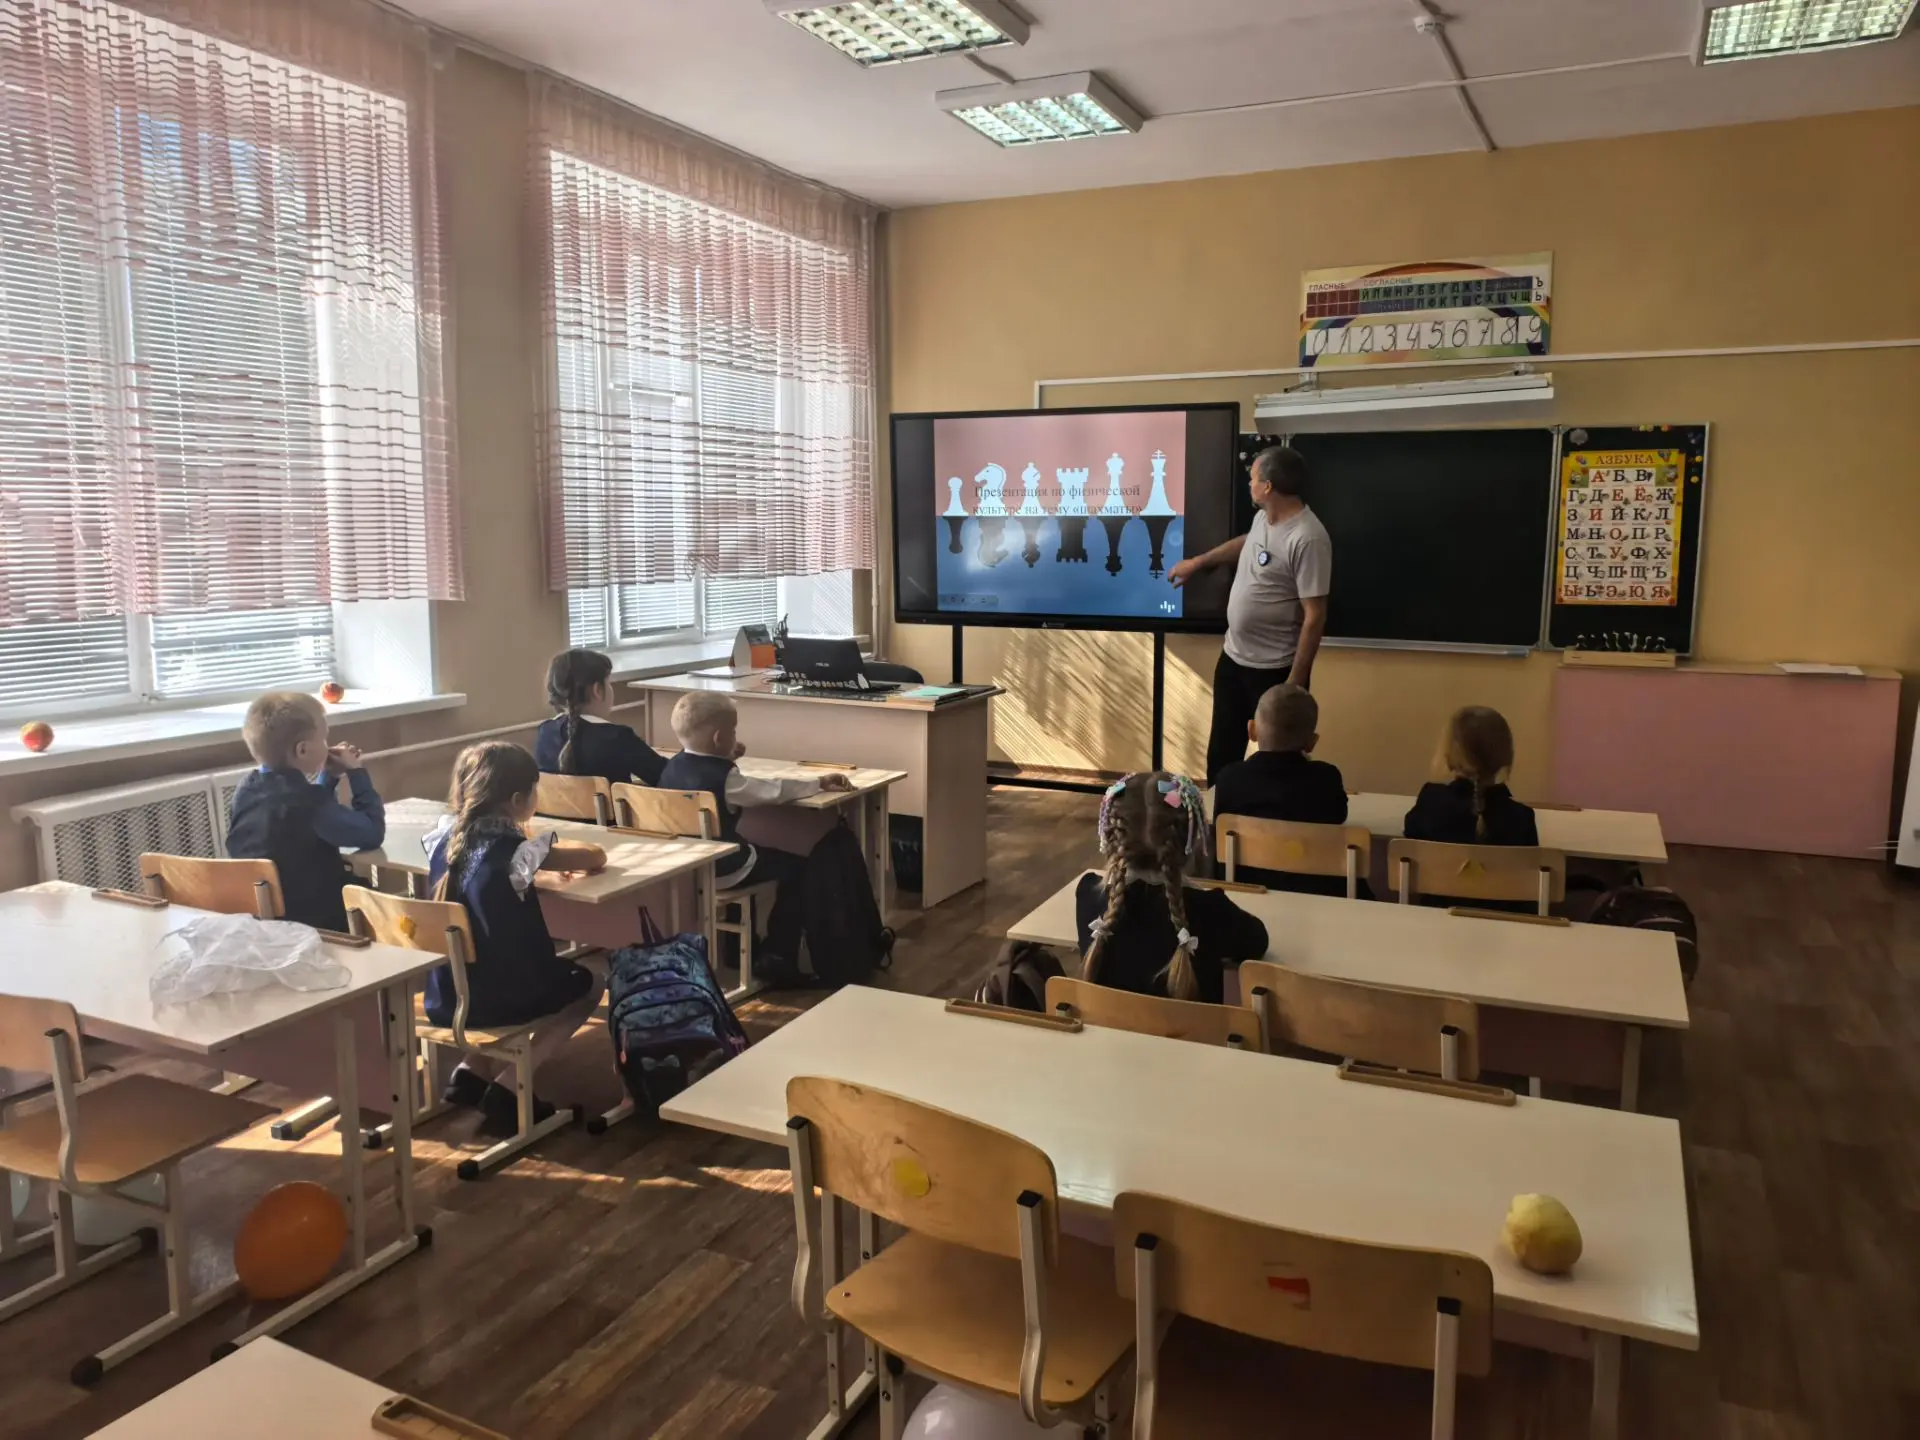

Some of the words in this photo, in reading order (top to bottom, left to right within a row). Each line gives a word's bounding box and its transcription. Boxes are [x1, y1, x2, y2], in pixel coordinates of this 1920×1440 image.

[1308, 282, 1345, 292] ГЛАСНЫЕ
[1536, 277, 1544, 288] Ъ
[1339, 326, 1350, 354] 1
[1359, 325, 1373, 352] 2
[1382, 324, 1396, 351] 3
[1407, 321, 1419, 351] 4
[1428, 320, 1443, 349] 5
[1452, 319, 1468, 347] 6
[1478, 318, 1493, 346] 7
[1501, 316, 1517, 345] 8
[1527, 315, 1542, 342] 9
[1596, 454, 1655, 465] АЗБУКА
[1591, 470, 1605, 482] А
[1613, 470, 1625, 481] Б
[1635, 469, 1647, 481] В
[974, 486, 1048, 500] Презентация
[1051, 488, 1066, 497] по
[1069, 484, 1140, 499] физической
[1569, 489, 1579, 502] Г
[1589, 489, 1603, 504] Д
[1612, 489, 1624, 501] Е
[1635, 485, 1646, 501] Ё
[1656, 488, 1673, 500] Ж
[972, 505, 1021, 516] культуре
[1025, 506, 1038, 515] на
[1042, 505, 1069, 516] тему
[1567, 508, 1578, 520] З
[1588, 508, 1603, 520] И
[1611, 505, 1625, 520] Й
[1633, 508, 1646, 520] К
[1656, 508, 1669, 520] Л
[1566, 528, 1580, 539] М
[1588, 528, 1601, 539] Н
[1609, 528, 1622, 540] О
[1631, 528, 1646, 539] П
[1654, 528, 1666, 539] Р
[1565, 547, 1577, 559] С
[1587, 547, 1599, 559] Т
[1609, 547, 1622, 559] У
[1630, 547, 1646, 559] Ф
[1654, 547, 1667, 559] Х
[1565, 566, 1579, 580] Ц
[1586, 566, 1599, 578] Ч
[1608, 566, 1624, 578] Ш
[1630, 566, 1647, 581] Щ
[1652, 566, 1667, 578] Ъ
[1606, 586, 1617, 597] Э
[1629, 586, 1645, 597] Ю
[1651, 586, 1664, 597] Я
